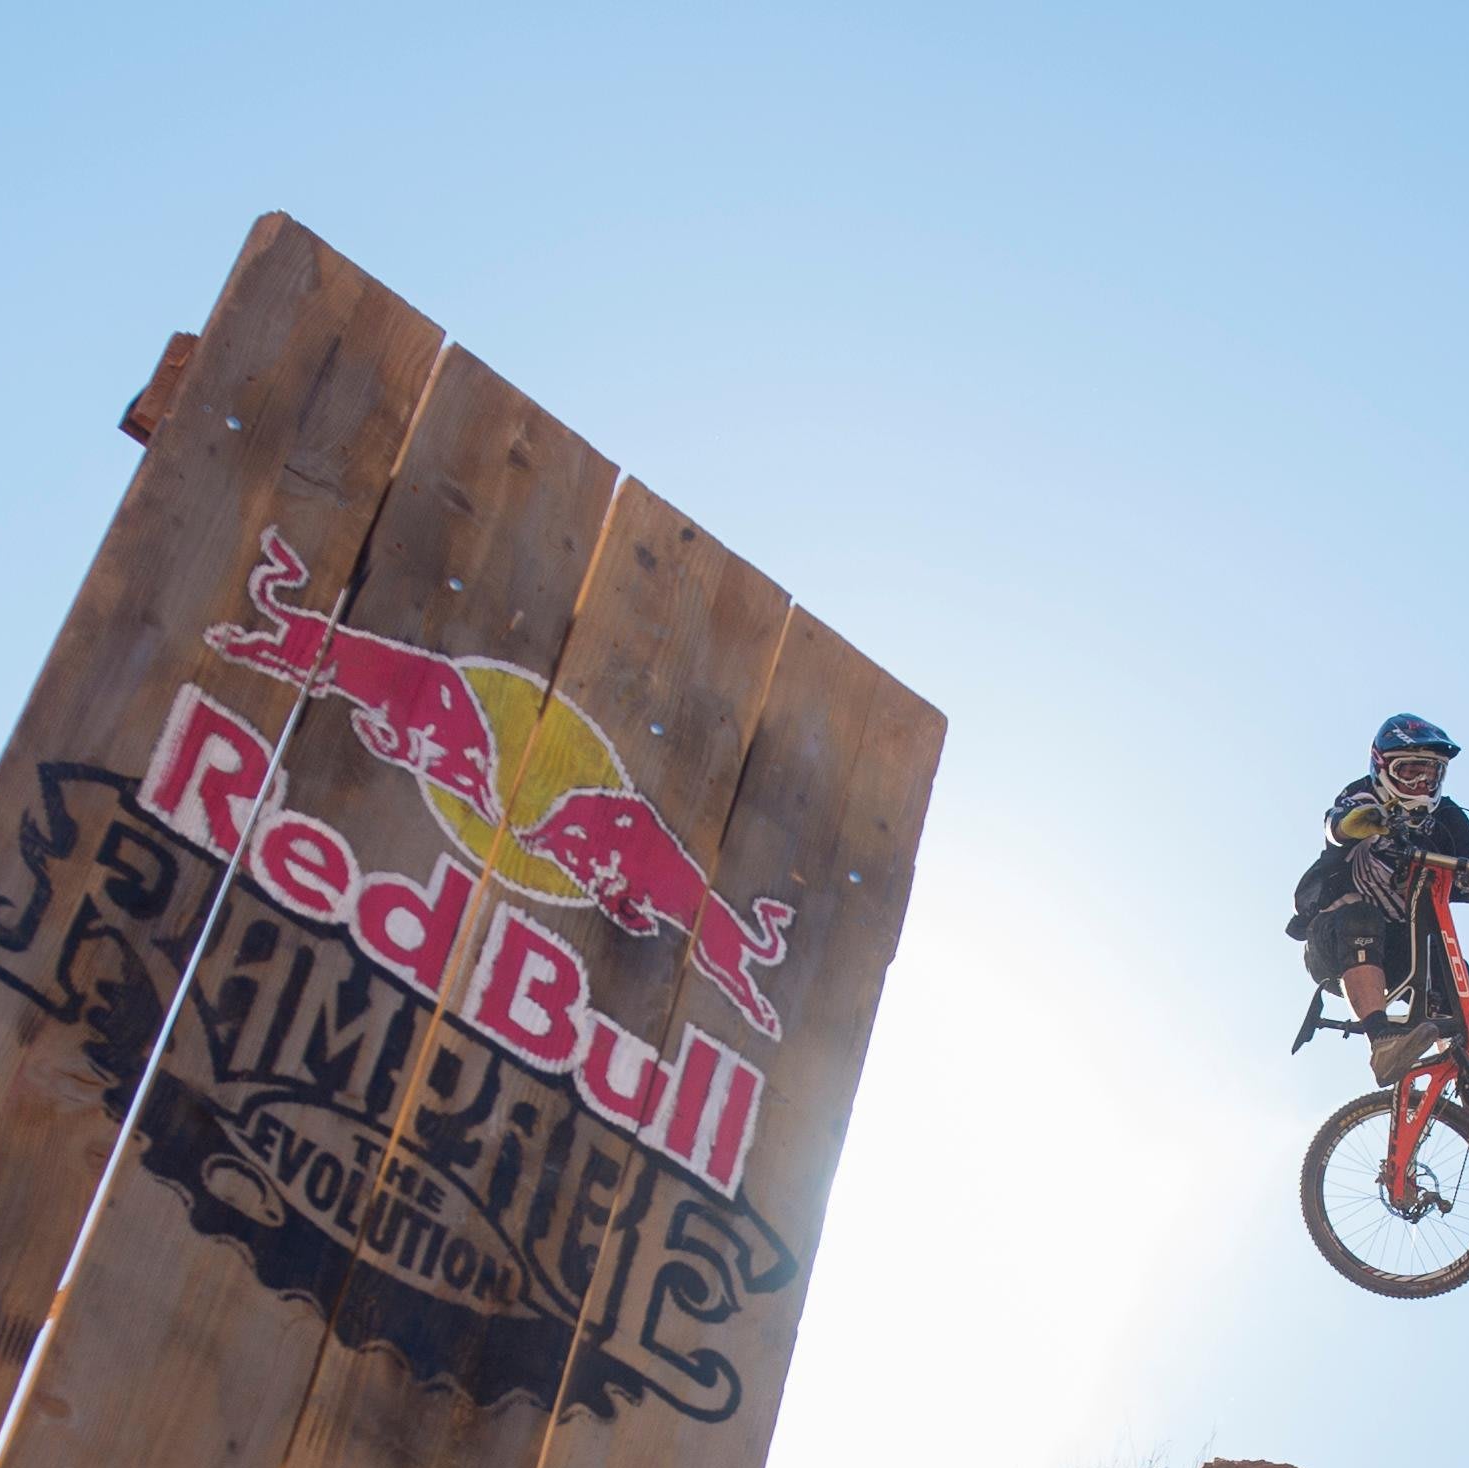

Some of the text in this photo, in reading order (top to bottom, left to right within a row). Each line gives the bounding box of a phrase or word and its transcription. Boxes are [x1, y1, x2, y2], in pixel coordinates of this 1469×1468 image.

[138, 684, 764, 1195] Red Bull
[1441, 930, 1469, 998] GT
[249, 1110, 513, 1304] EVOLUTION
[352, 1134, 447, 1213] THE
